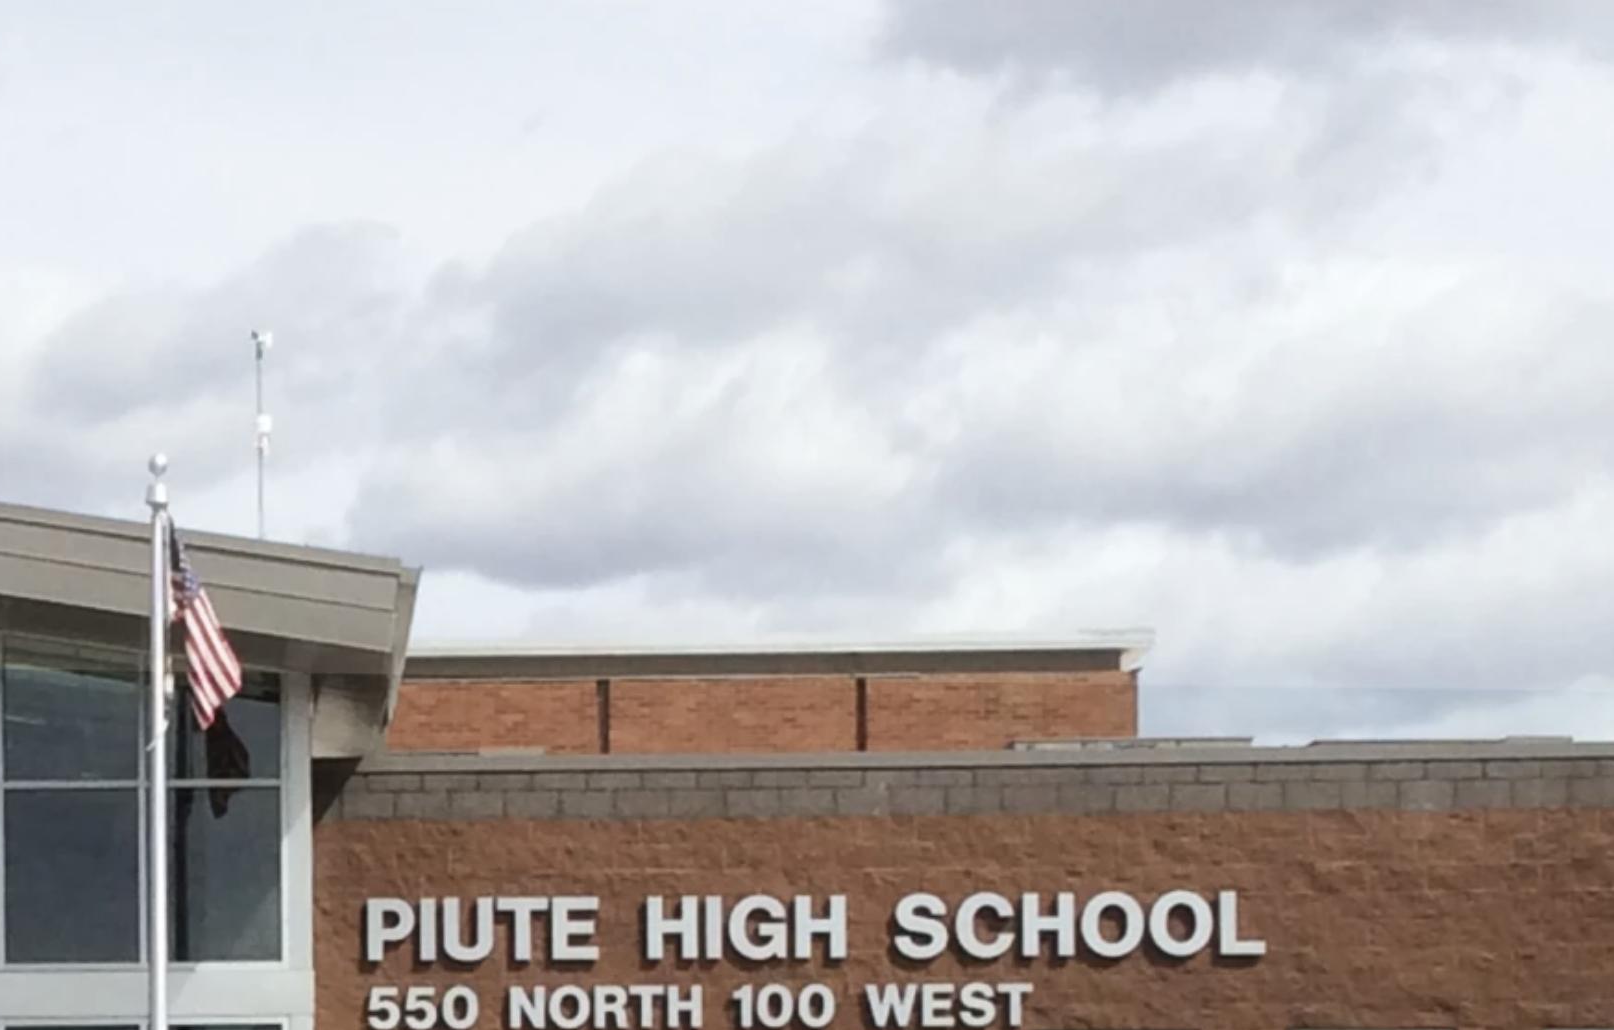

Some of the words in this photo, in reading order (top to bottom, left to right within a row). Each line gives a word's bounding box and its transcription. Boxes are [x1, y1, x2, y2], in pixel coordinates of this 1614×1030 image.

[366, 896, 600, 961] PIUTE
[646, 894, 848, 960] HIGH
[894, 889, 1267, 959] SCHOOL
[368, 985, 479, 1030] 550
[508, 984, 703, 1029] NORTH
[732, 983, 835, 1028] 100
[864, 982, 1034, 1027] WEST
